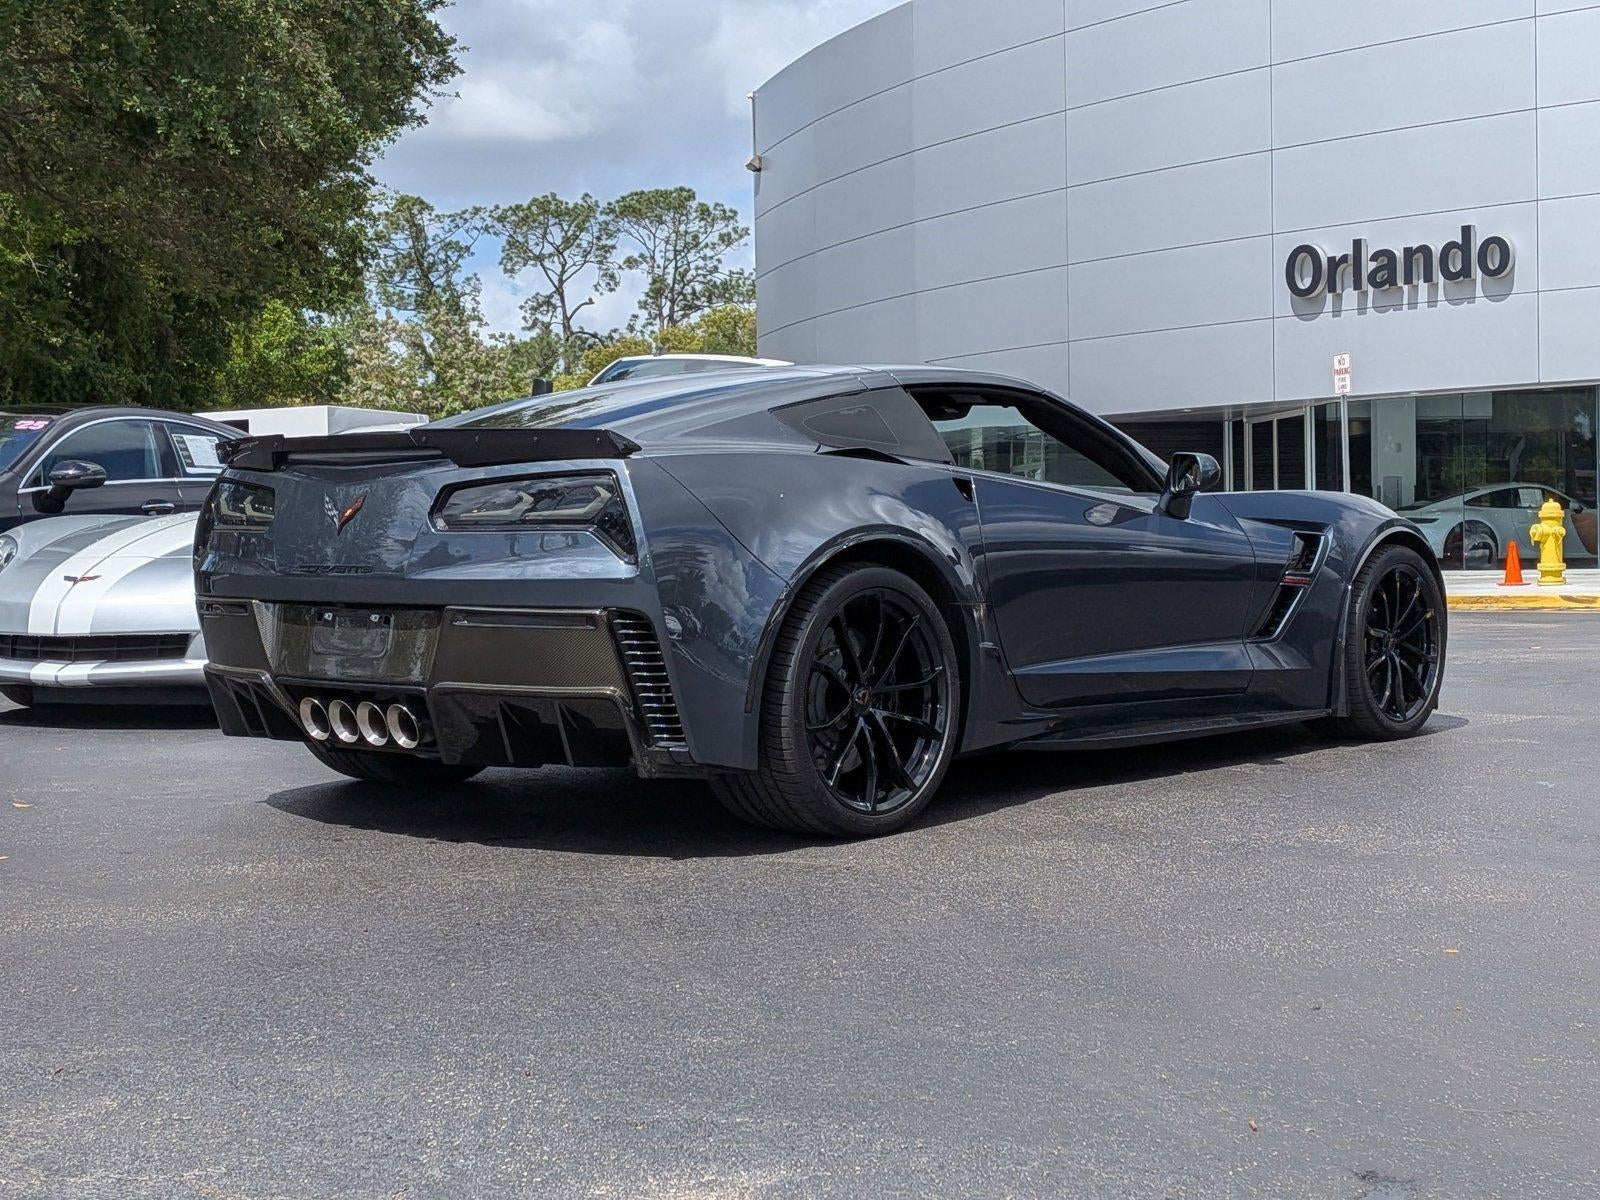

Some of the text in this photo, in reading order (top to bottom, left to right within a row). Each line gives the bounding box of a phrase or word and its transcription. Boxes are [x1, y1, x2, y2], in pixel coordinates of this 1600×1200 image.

[1285, 224, 1514, 299] Orlando
[1338, 357, 1345, 367] NO
[1334, 367, 1350, 376] PARKING
[14, 420, 49, 431] 25
